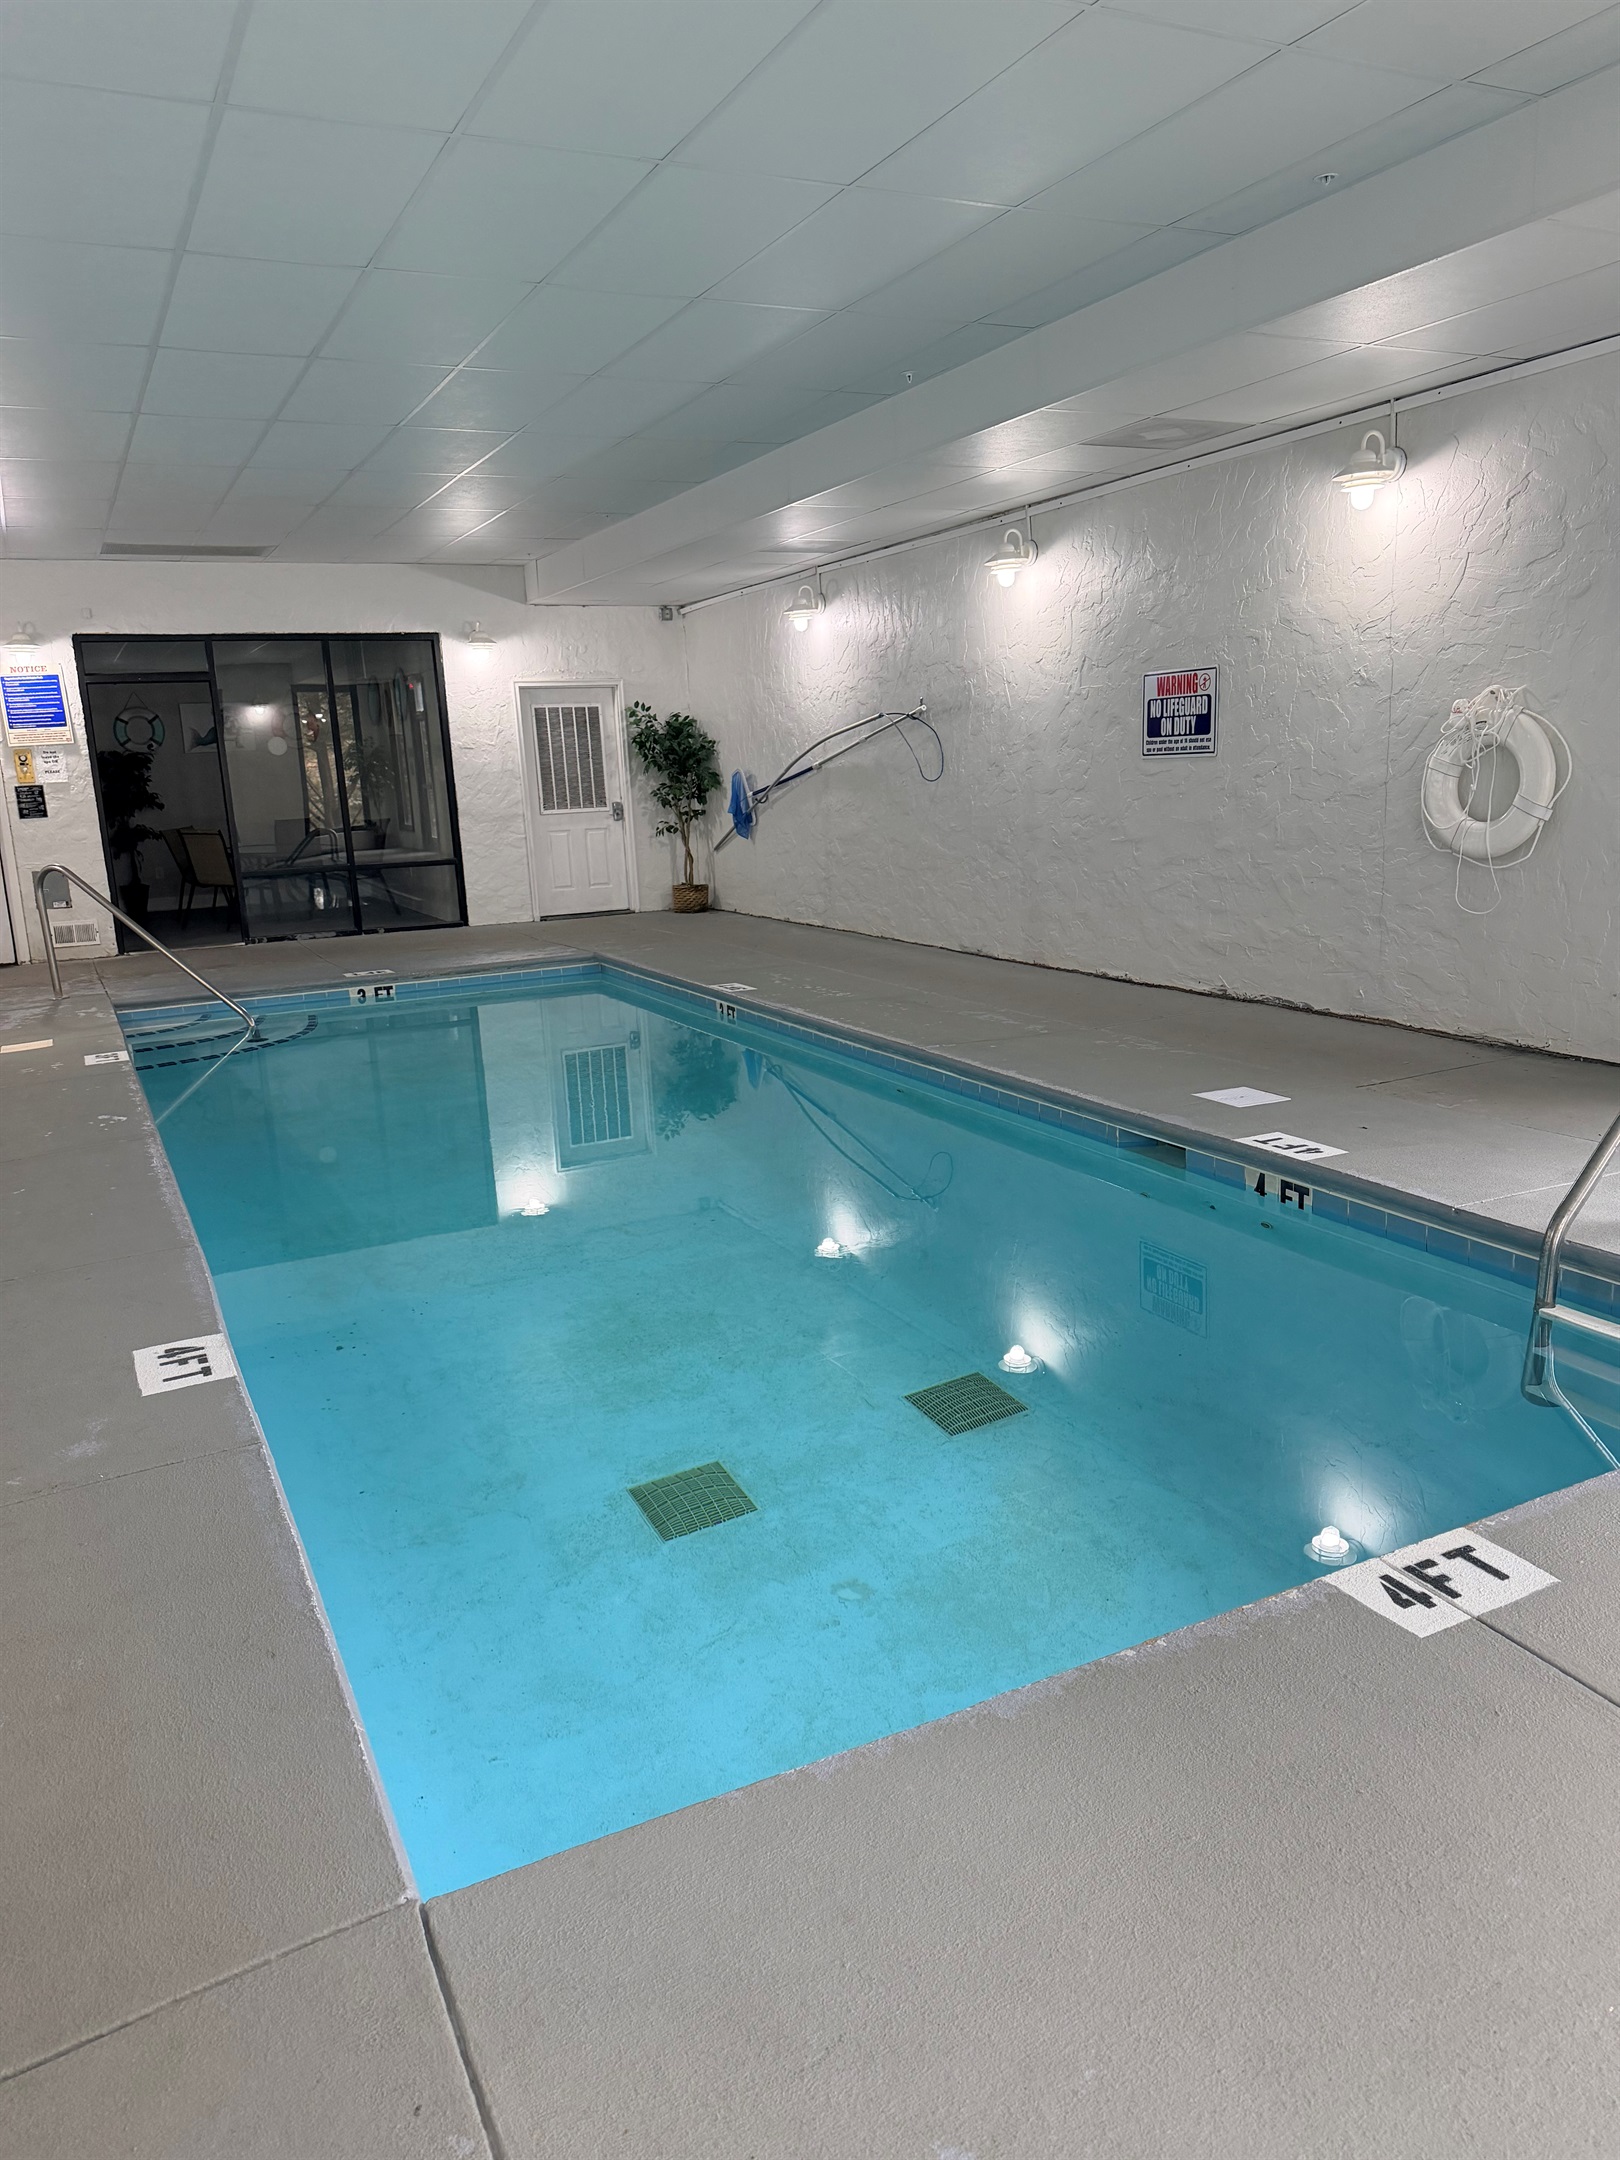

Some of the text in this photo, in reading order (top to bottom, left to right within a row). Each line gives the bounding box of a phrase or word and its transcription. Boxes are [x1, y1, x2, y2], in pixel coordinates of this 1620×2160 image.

[9, 665, 48, 673] NOTICE
[1157, 672, 1199, 697] WARNING
[1150, 695, 1208, 718] NO LIFEGUARD
[1160, 715, 1197, 736] ON DUTY
[1253, 1172, 1310, 1210] 4 FT
[157, 1345, 213, 1382] 4FT
[1379, 1544, 1510, 1610] 4FT
